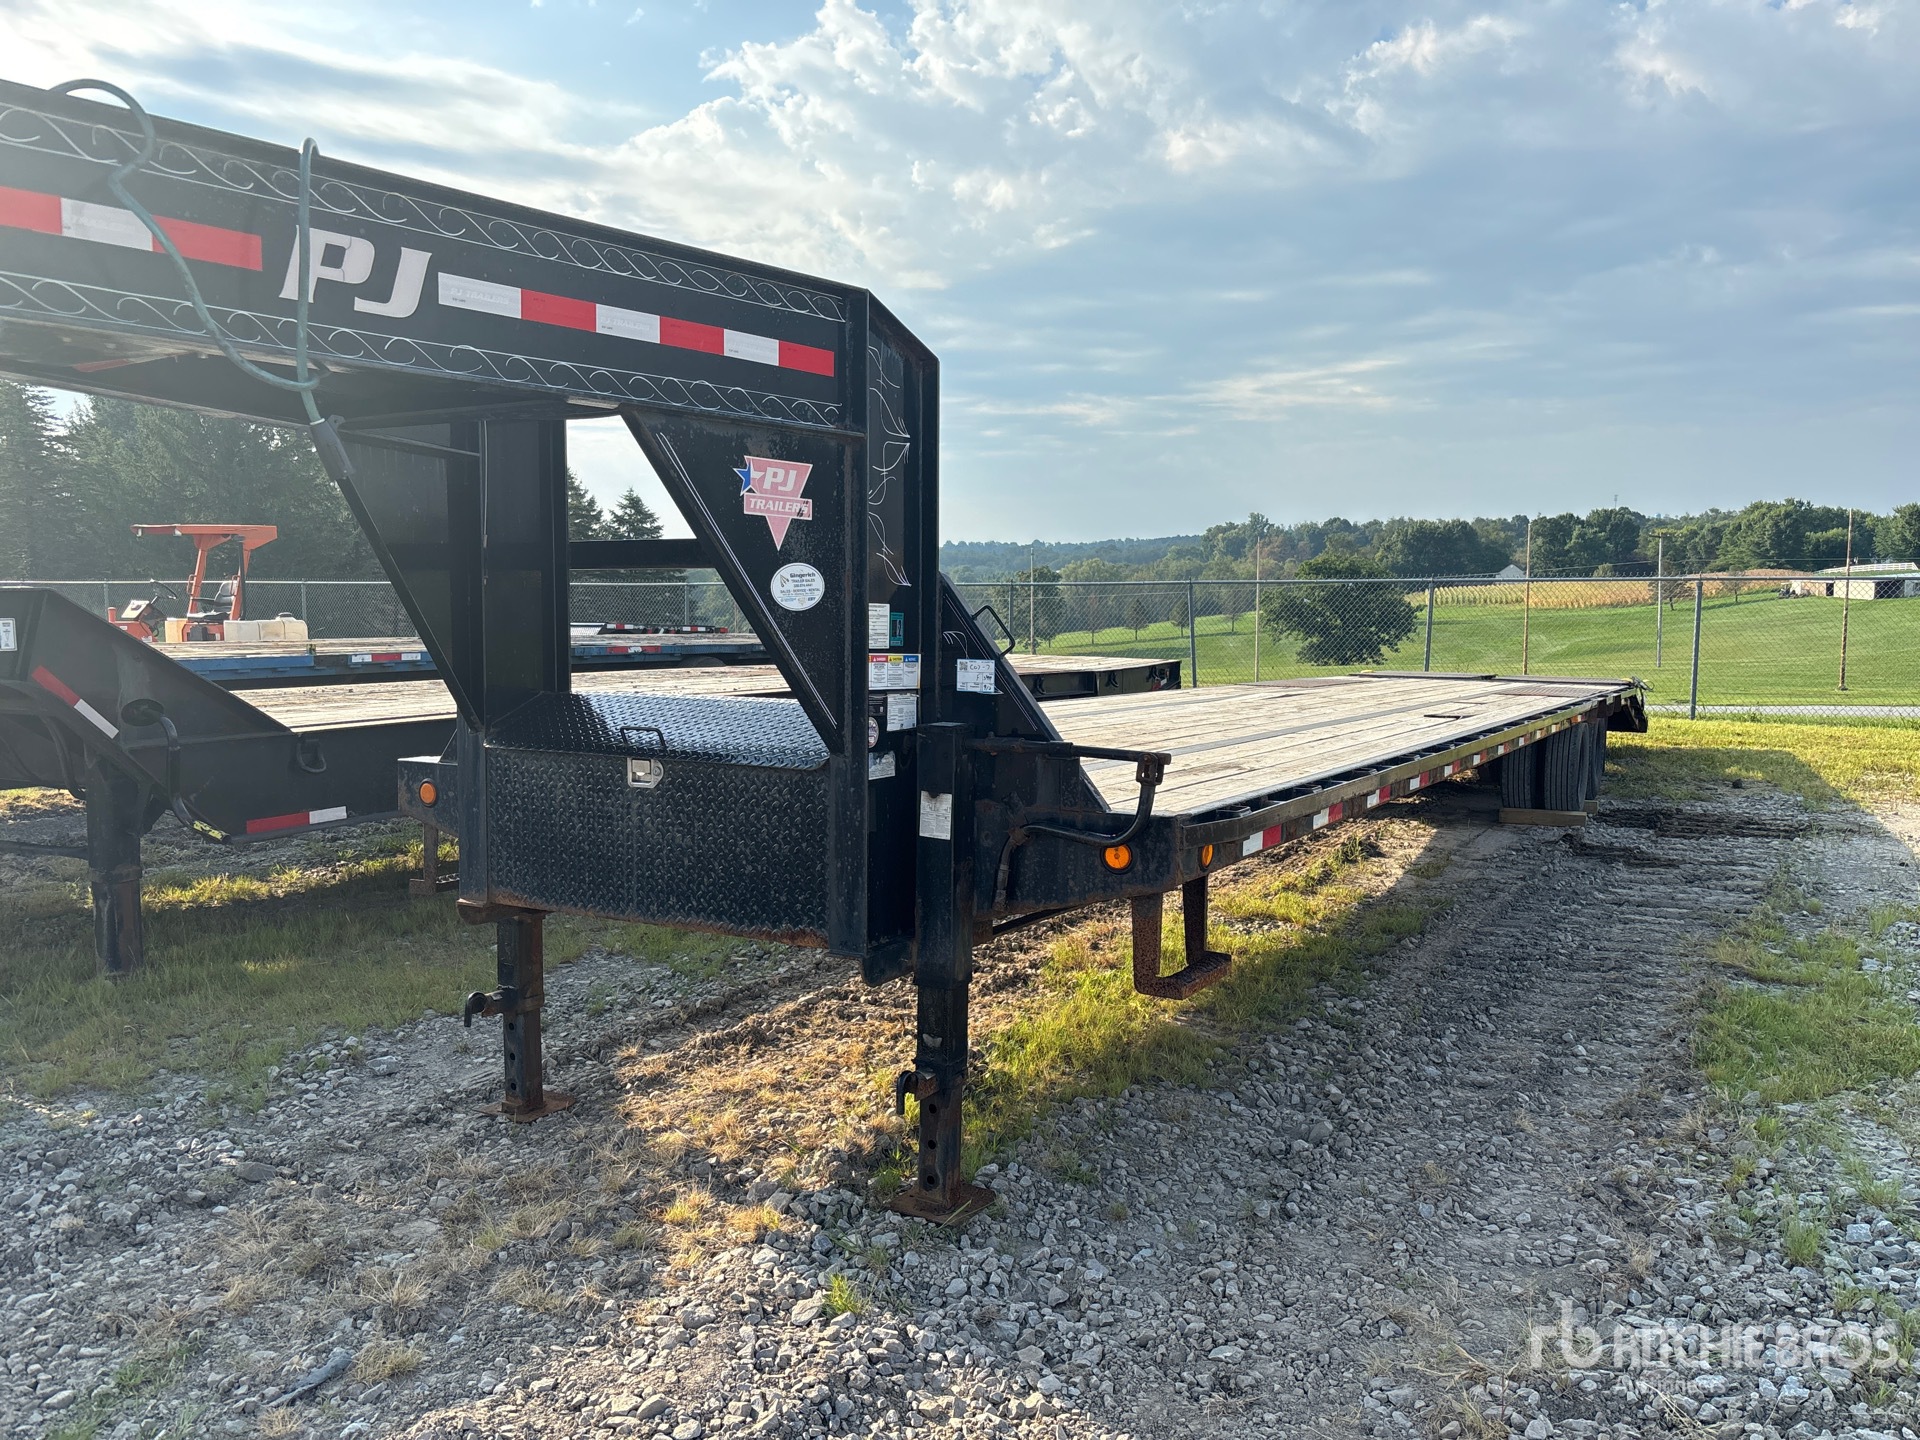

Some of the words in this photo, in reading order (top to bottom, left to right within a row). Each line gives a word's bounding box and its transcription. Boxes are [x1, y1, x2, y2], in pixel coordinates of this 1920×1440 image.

[278, 224, 433, 319] PJ
[762, 467, 798, 492] PJ
[749, 498, 809, 514] TRAILERS
